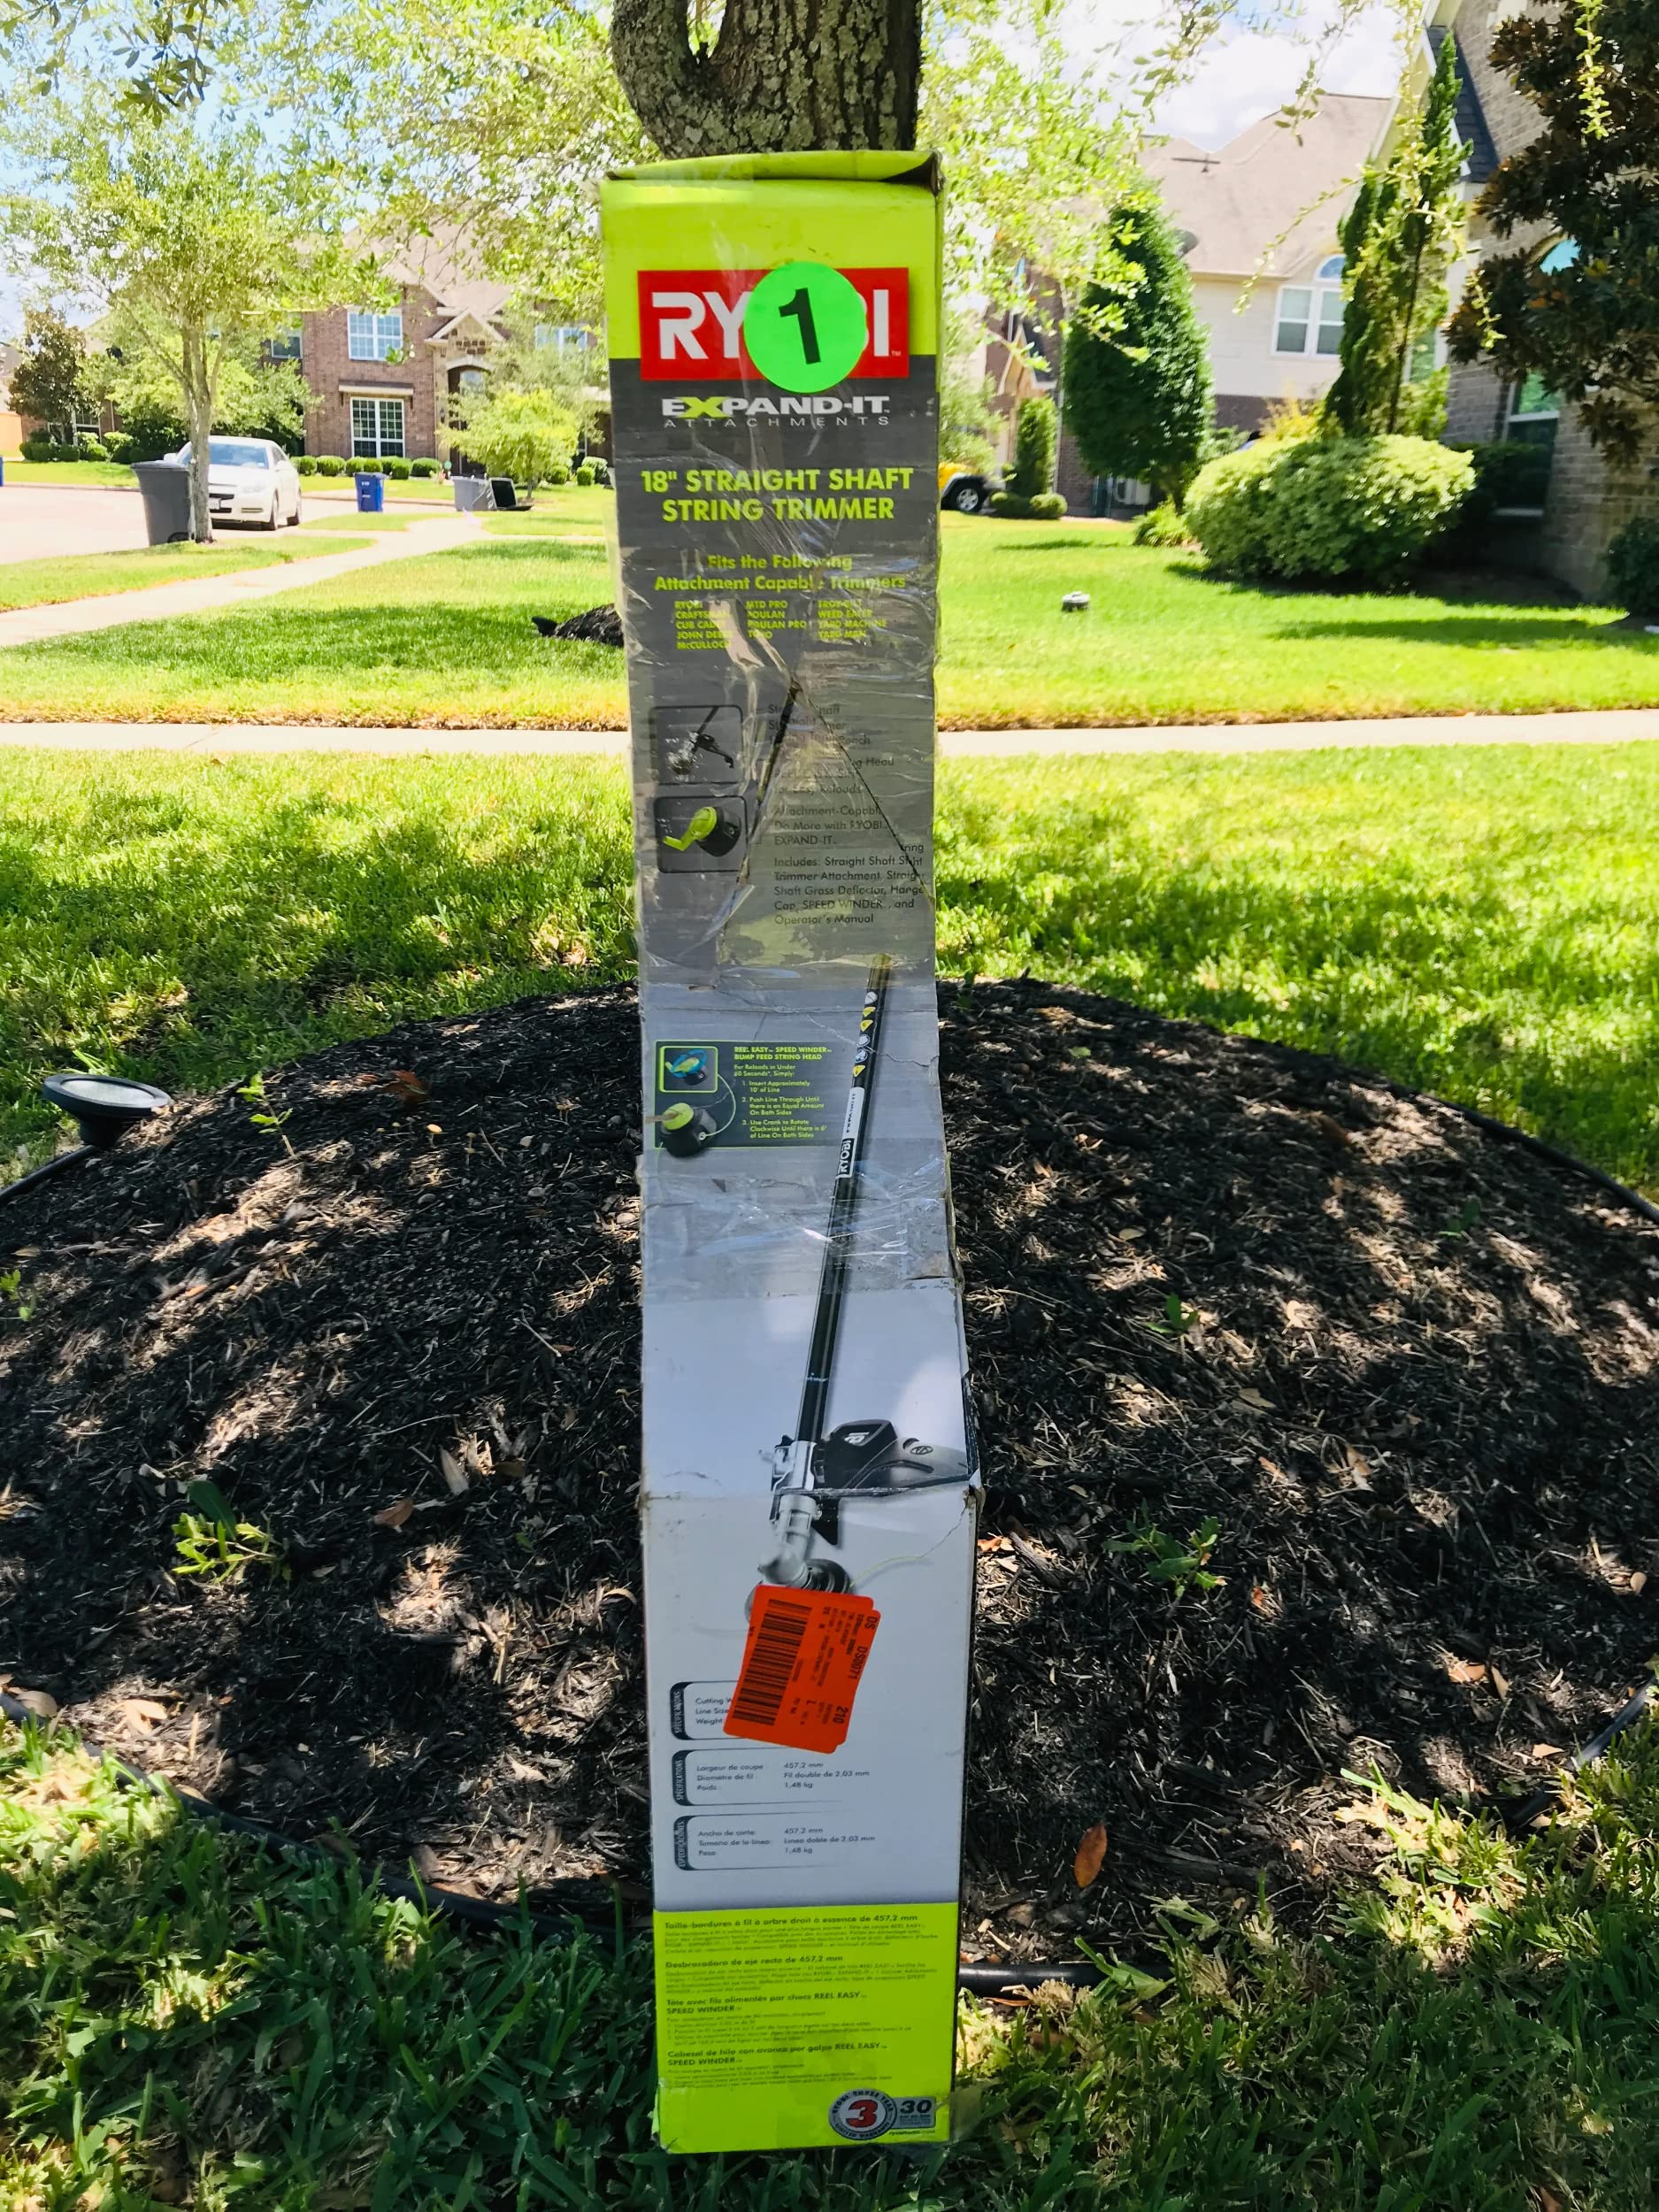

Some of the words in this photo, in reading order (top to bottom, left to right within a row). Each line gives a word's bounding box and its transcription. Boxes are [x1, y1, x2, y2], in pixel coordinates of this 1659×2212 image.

[652, 290, 889, 359] RYI
[779, 288, 821, 365] 1
[662, 396, 889, 418] EXPAND-IT
[664, 417, 889, 427] ATTACHMENTS
[641, 471, 677, 492] 18"
[686, 469, 821, 492] STRAIGHT
[828, 468, 913, 490] SHAFT
[663, 499, 764, 522] STRING
[772, 497, 895, 520] TRIMMER
[708, 555, 735, 568] Fits
[741, 554, 767, 568] the
[655, 575, 749, 590] Attachment
[825, 856, 865, 868] Straight
[869, 856, 895, 866] Shaft
[774, 872, 818, 881] Trimmer
[774, 887, 802, 896] Shaft
[804, 886, 834, 895] Grass
[803, 901, 834, 910] SPEED
[895, 899, 915, 908] and
[834, 913, 873, 923] Manual
[838, 1140, 852, 1174] RYOBI
[808, 2044, 833, 2053] golpe
[846, 2099, 879, 2128] 3
[900, 2100, 933, 2114] 30
